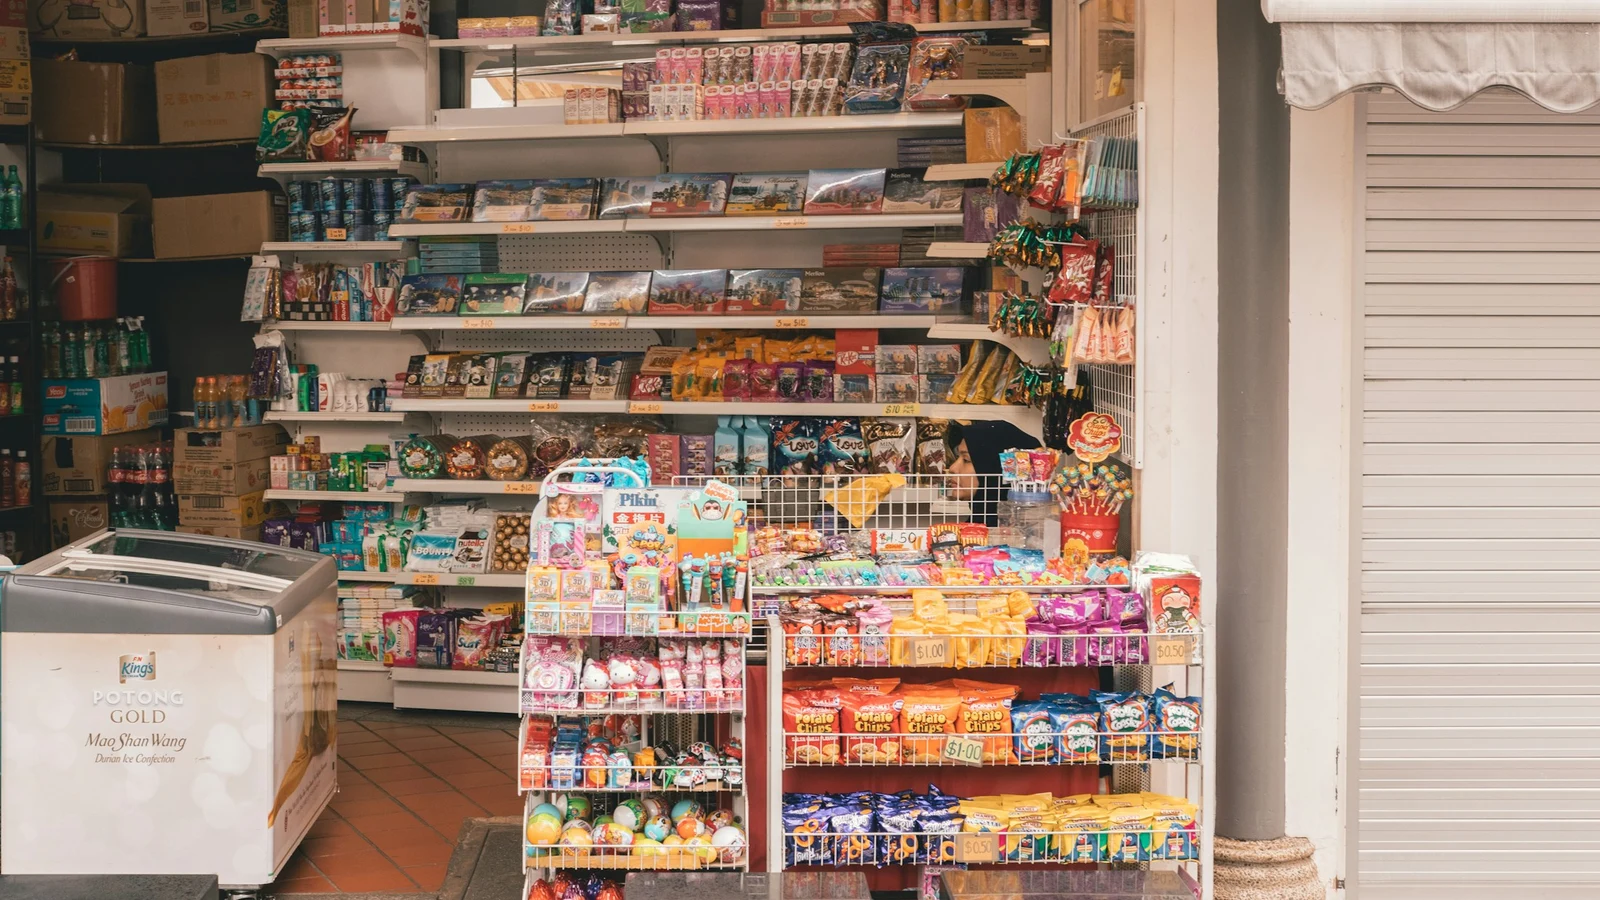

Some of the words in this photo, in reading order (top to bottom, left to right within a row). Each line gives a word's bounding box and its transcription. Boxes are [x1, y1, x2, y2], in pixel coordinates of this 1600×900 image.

[619, 493, 657, 507] Pikin
[416, 547, 453, 556] BOUNTY
[458, 637, 481, 648] Surf
[917, 643, 944, 660] $1.00
[1157, 644, 1184, 658] $0.50
[121, 662, 153, 678] King's
[92, 690, 184, 706] POTONG
[110, 709, 166, 723] GOLD
[795, 713, 835, 724] Potato
[854, 711, 894, 722] Potato
[907, 712, 946, 724] Potato
[963, 711, 1003, 721] Potato
[796, 723, 833, 733] Chips
[855, 722, 891, 733] Chips
[908, 722, 944, 734] Chips
[965, 721, 1002, 733] Chips
[1026, 721, 1053, 734] Rolle
[85, 732, 116, 747] Mao
[111, 732, 149, 752] Shan
[151, 733, 187, 752] Wang
[946, 740, 982, 760] $1.00
[95, 753, 121, 763] Durian
[123, 753, 134, 763] Ice
[136, 753, 176, 766] Confection
[965, 840, 992, 854] $0.50
